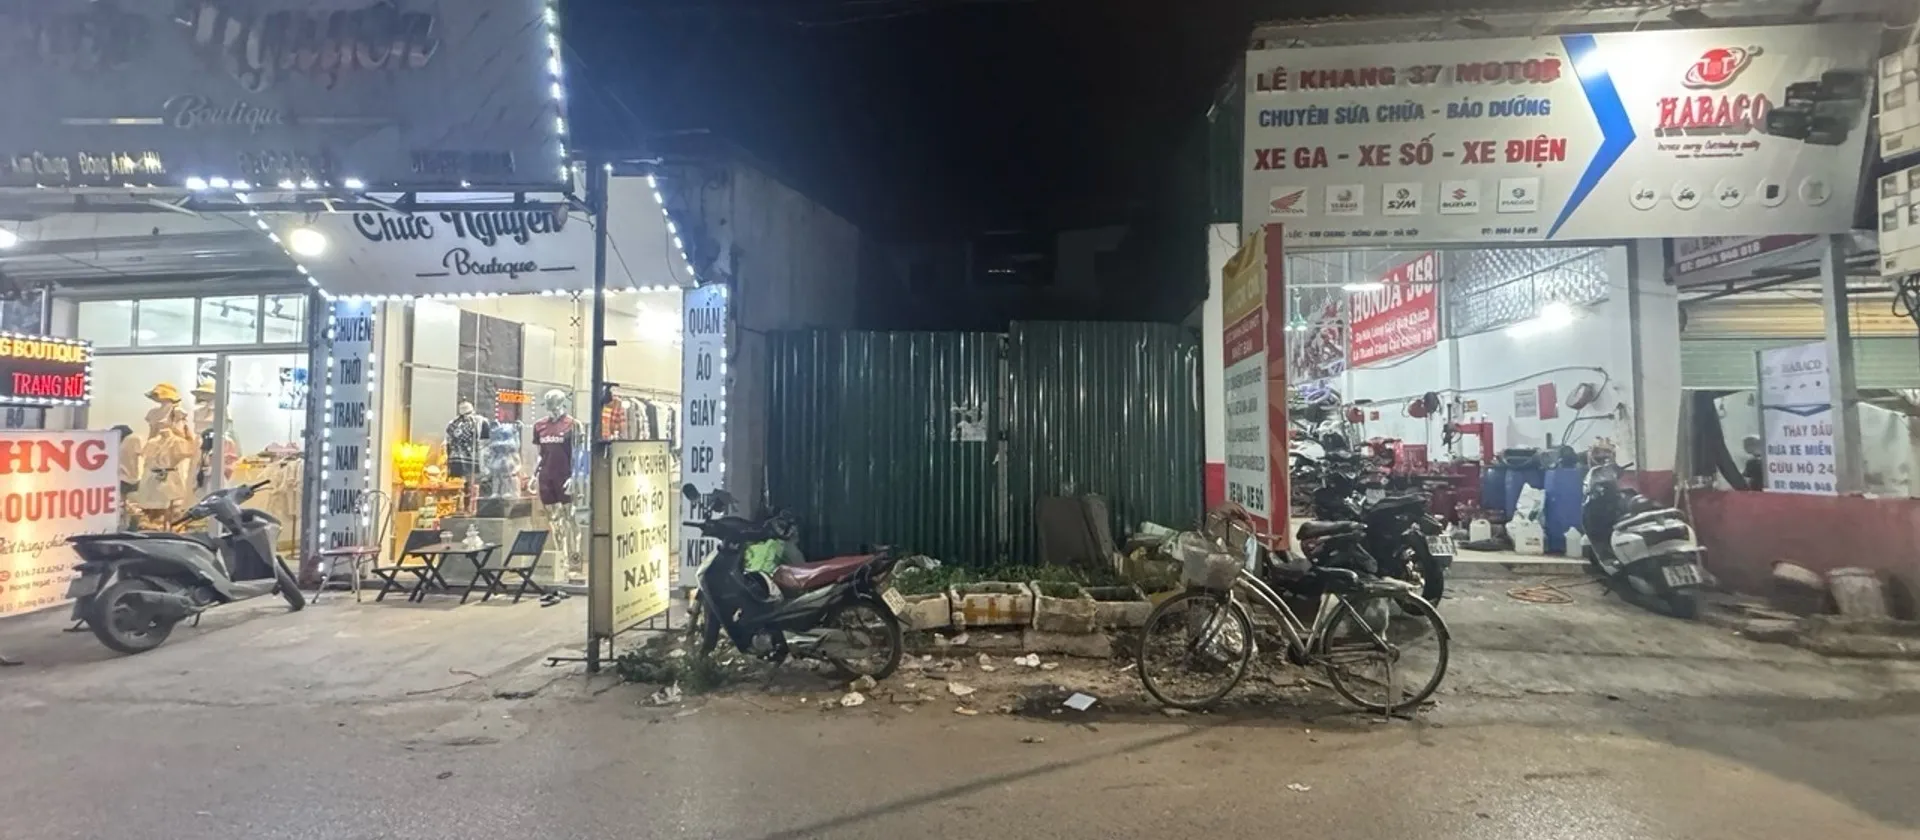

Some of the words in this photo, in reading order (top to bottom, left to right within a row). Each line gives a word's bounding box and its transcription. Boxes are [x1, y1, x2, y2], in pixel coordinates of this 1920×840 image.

[1256, 66, 1287, 92] LÊ
[1300, 66, 1396, 89] KHANG
[1408, 64, 1442, 85] 37
[1455, 58, 1561, 84] MOTOR
[164, 94, 285, 135] Boutique
[1259, 104, 1329, 127] CHUYÊN
[1335, 102, 1370, 124] SỬA
[1376, 100, 1424, 122] CHỮA
[1447, 97, 1483, 119] BẢO
[1488, 94, 1551, 117] DƯỠNG
[1656, 93, 1771, 134] HABACO
[1253, 148, 1286, 170] XE
[1293, 146, 1329, 169] GA
[1358, 144, 1391, 167] XE
[1399, 133, 1436, 165] SỐ
[1461, 141, 1497, 164] XE
[1505, 134, 1567, 168] ĐIỆN
[1387, 200, 1416, 209] SYM
[443, 247, 537, 279] Boutique
[1353, 273, 1402, 324] HONDA
[334, 312, 371, 342] CHUYÊN
[12, 340, 86, 363] BOUTIQUE
[696, 347, 712, 380] ÁO
[12, 372, 62, 397] TRANG
[64, 372, 84, 397] NỮ
[340, 352, 361, 385] THỜI
[334, 402, 365, 428] TRANG
[1783, 424, 1808, 437] THAY
[335, 445, 358, 471] NAM
[691, 440, 714, 473] DÉP
[1790, 444, 1801, 455] XE
[0, 486, 116, 523] OUTIQUE
[624, 559, 661, 592] NAM
